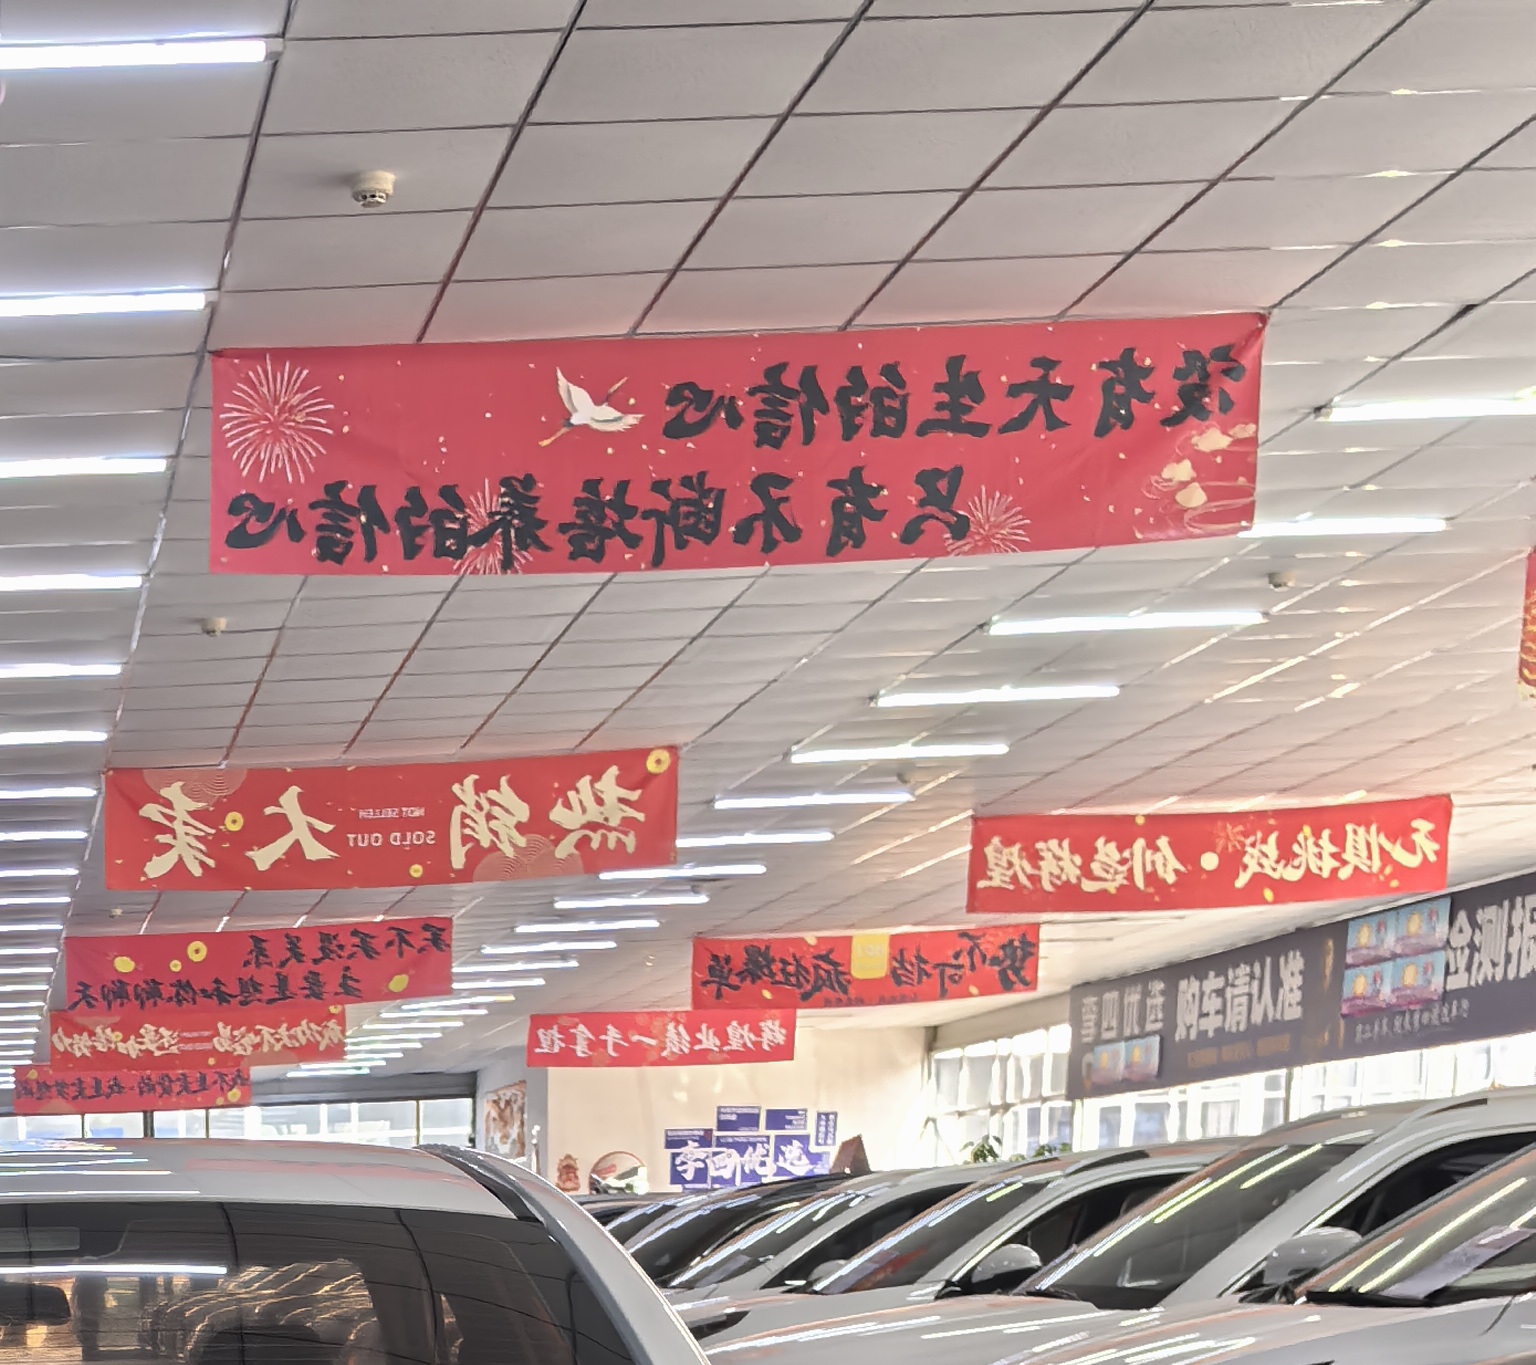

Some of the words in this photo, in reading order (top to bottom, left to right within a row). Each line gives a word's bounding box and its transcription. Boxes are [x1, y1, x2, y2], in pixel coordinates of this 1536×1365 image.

[1175, 948, 1306, 1043] 购车请认准
